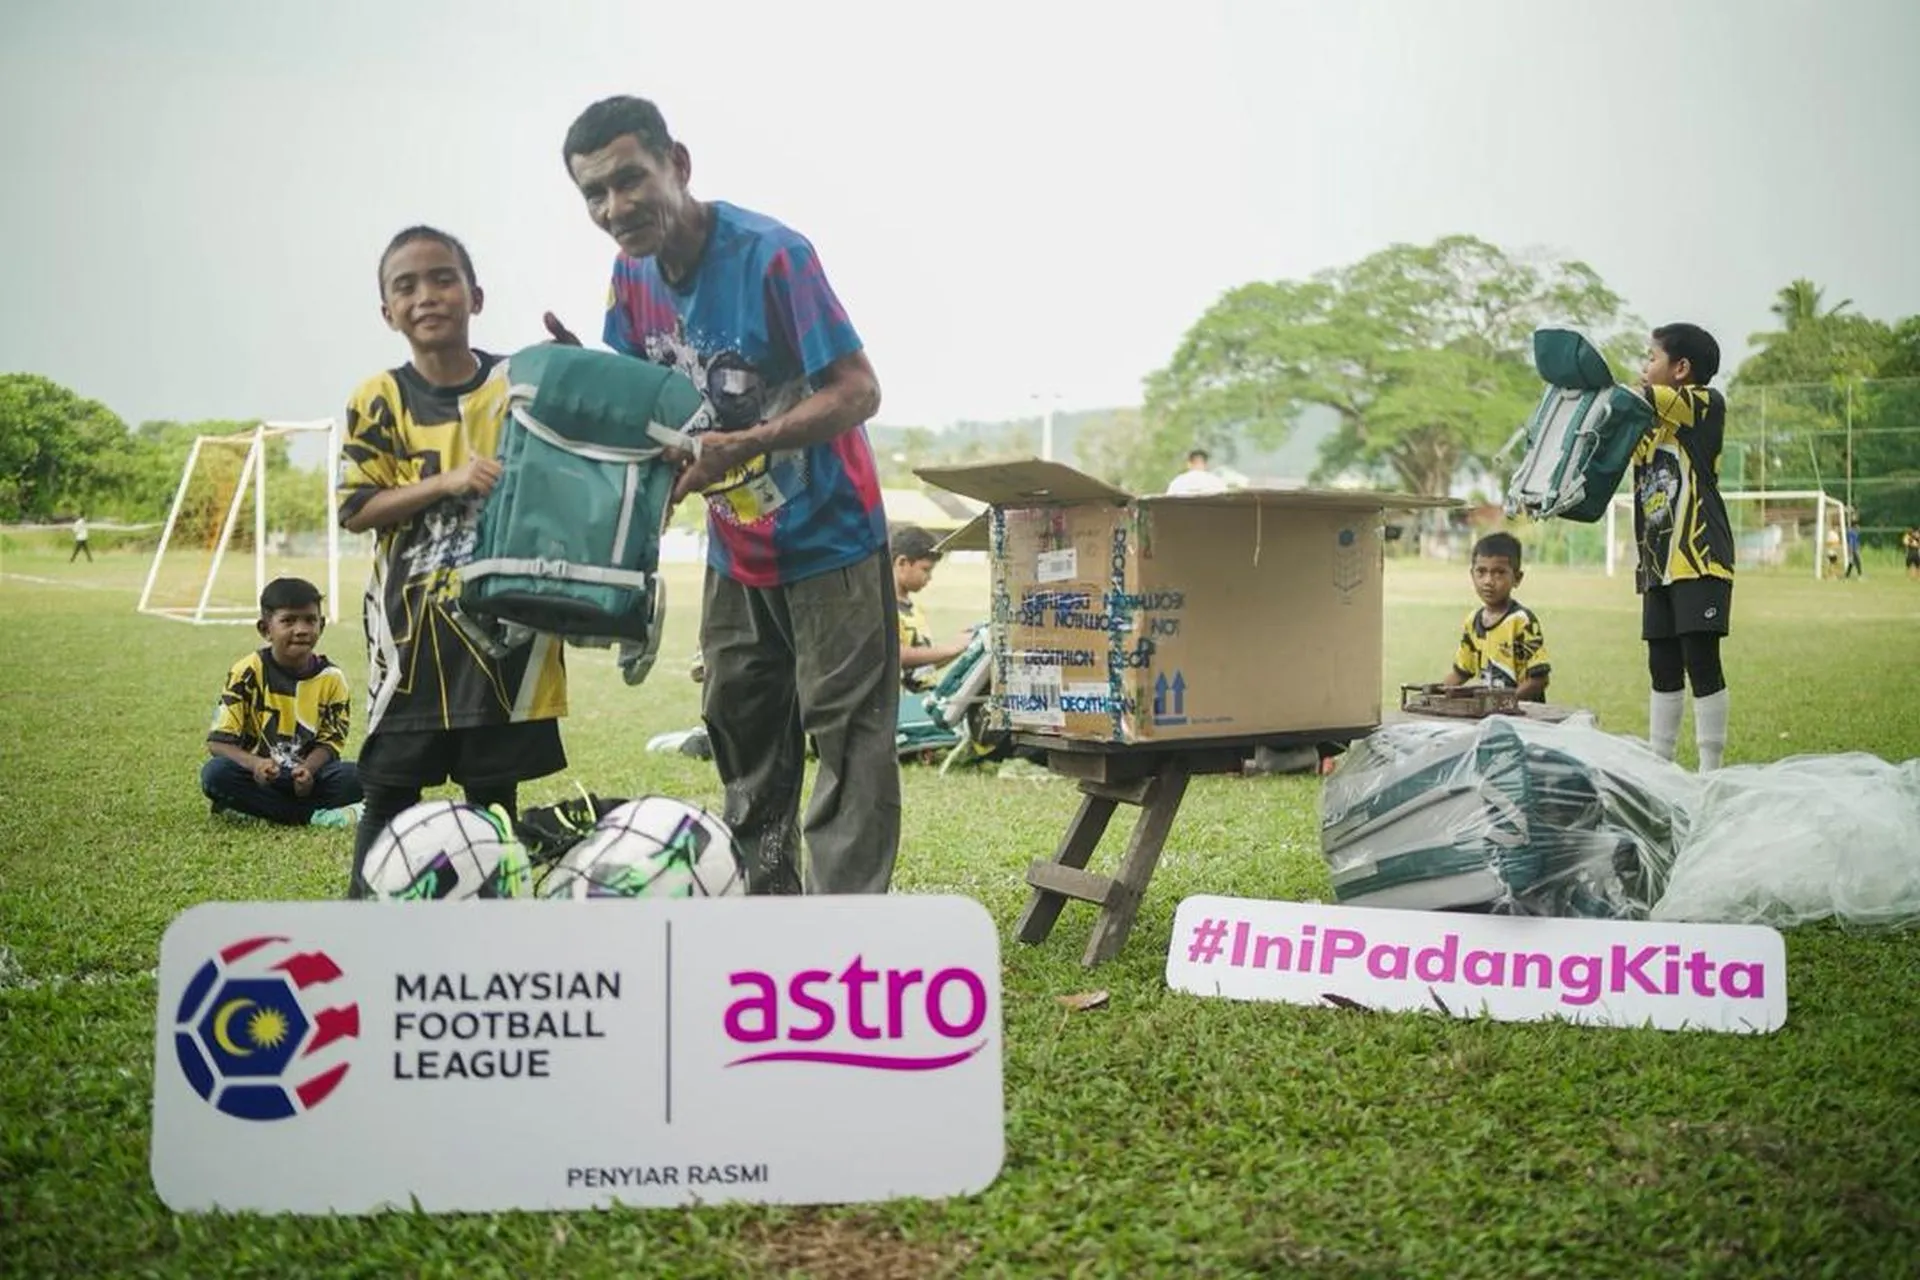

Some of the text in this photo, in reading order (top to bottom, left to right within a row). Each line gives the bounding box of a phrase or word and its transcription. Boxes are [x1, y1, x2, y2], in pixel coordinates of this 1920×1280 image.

[1024, 649, 1095, 667] DECATHLON
[1189, 918, 1764, 1005] #IniPadangKita
[396, 971, 621, 1001] MALAYSIAN
[724, 955, 987, 1043] astro
[395, 1010, 605, 1041] FOOTBALL
[394, 1049, 550, 1080] LEAGUE
[567, 1164, 768, 1187] PENYIAR RASMI
